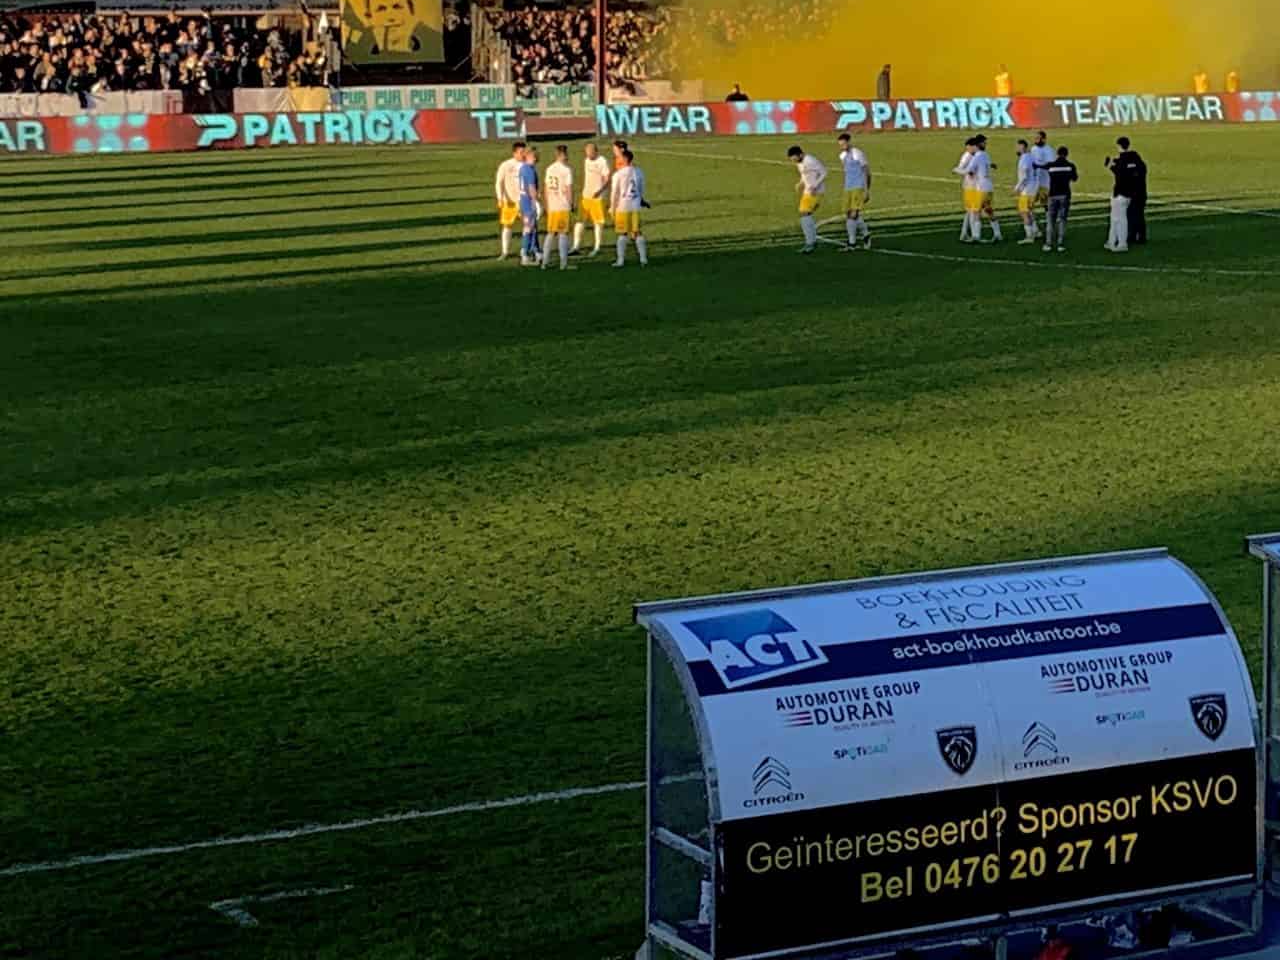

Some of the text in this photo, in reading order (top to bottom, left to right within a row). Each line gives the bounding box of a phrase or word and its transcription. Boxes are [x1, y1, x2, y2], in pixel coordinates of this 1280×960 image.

[471, 110, 527, 139] TE
[871, 97, 1015, 129] PATRICK
[1054, 94, 1224, 125] TEAMWEAR
[243, 109, 421, 146] PATRICK
[855, 573, 1087, 610] BOEKHOUDING
[894, 592, 1085, 630] & FISCALITEIT
[710, 630, 815, 672] ACT
[891, 619, 1122, 660] act-boekhoudkantoor.be
[1040, 650, 1173, 679] AUTOMOTIVE GROUP
[1076, 668, 1150, 693] DURAN
[776, 680, 921, 712] AUTOMOTIVE GROUP
[815, 699, 894, 726] DURAN
[745, 774, 1238, 875] Geïnteresseerd? Sponsor KSVO
[859, 832, 1140, 904] Bel 0476 20 27 17
